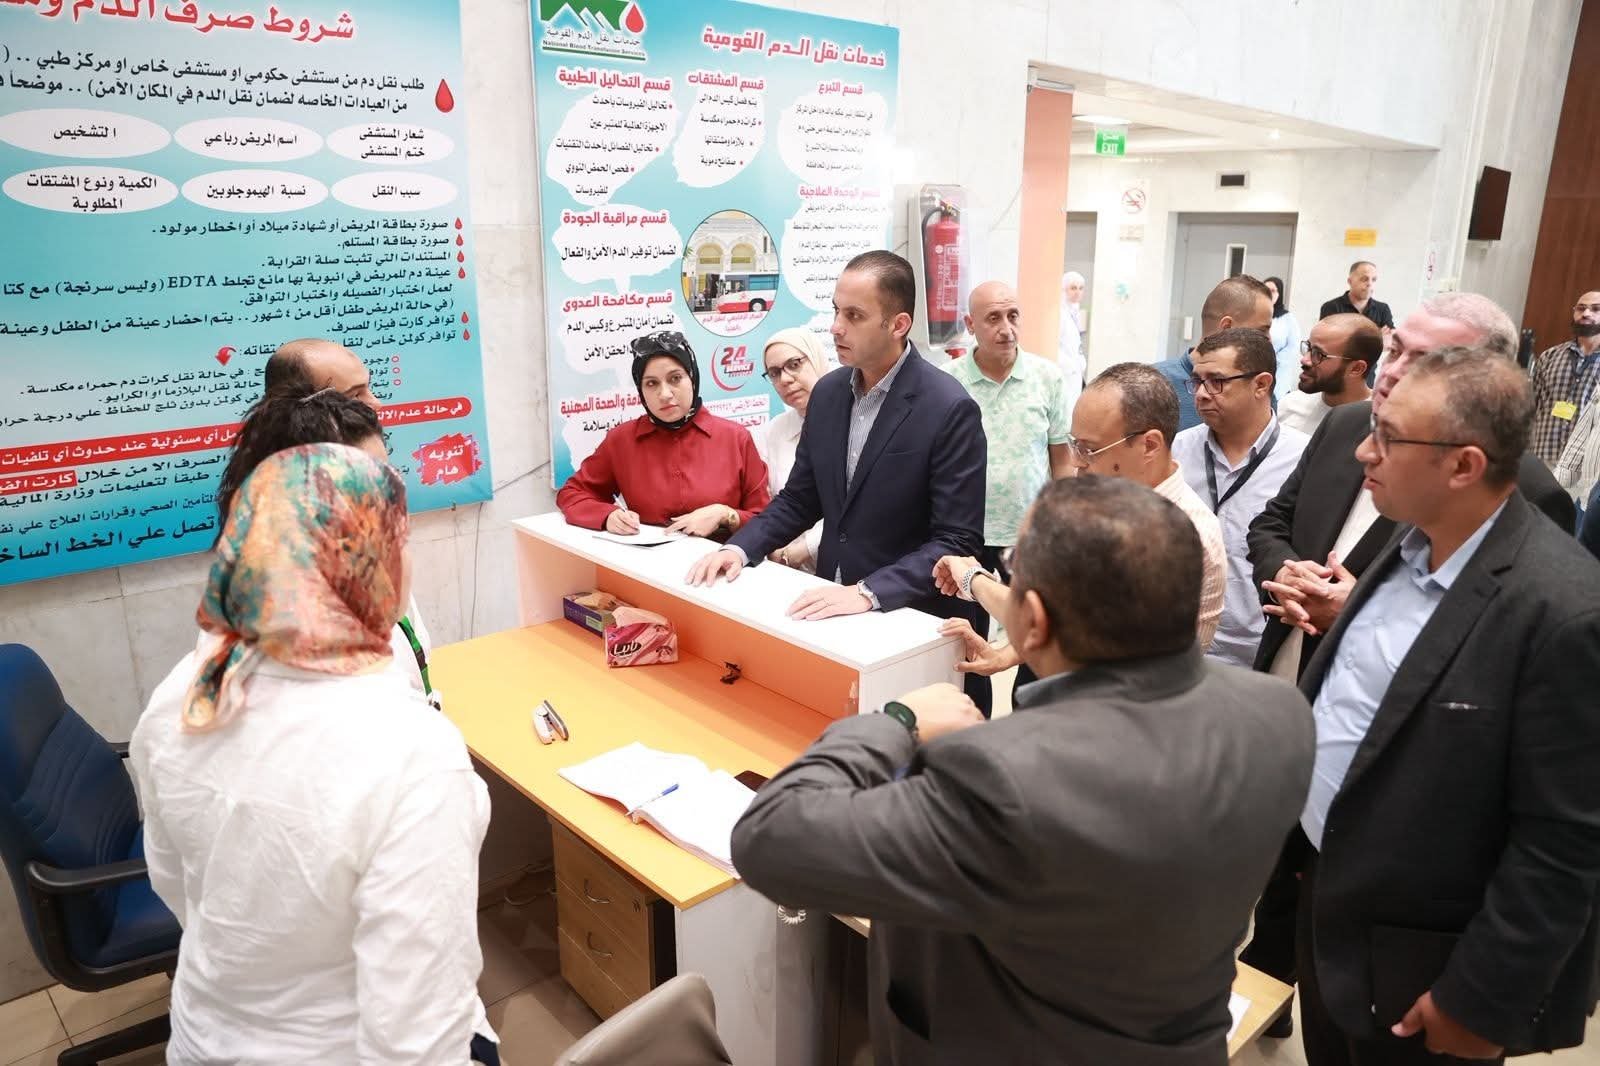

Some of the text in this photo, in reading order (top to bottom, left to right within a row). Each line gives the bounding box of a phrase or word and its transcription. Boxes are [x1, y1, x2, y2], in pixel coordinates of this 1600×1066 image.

[165, 0, 354, 43] شروط صرف
[703, 28, 764, 52] القومية
[813, 41, 838, 63] نقل
[843, 47, 885, 67] خدمات
[36, 50, 425, 90] طلب نقل من مستشفى حكومي مستشفى خاص مركز طبي
[558, 69, 671, 93] قسم التحاليل الطبية
[688, 71, 764, 92] قسم المشتقات
[136, 83, 390, 112] العيادات لضمان نقل الدم في المكان
[842, 84, 863, 96] قسم
[204, 132, 298, 148] اسم المريض رباعي
[359, 127, 425, 141] شعار المستشفى
[360, 146, 425, 160] ختم المستشفى
[1101, 143, 1119, 155] EXIT
[26, 173, 157, 192] الكمية ونوع المشتقات
[206, 184, 306, 199] نسبة الهيموجلوبين
[372, 185, 421, 198] سبب النقل
[72, 196, 123, 212] المطلوبة
[159, 219, 449, 236] صورة بطاقة المريض شهادة ميلاد مولود
[563, 211, 667, 227] قسم مراقبة الجودة
[383, 235, 450, 247] صورة بطاقة
[315, 252, 451, 267] المستندات التي صلة
[561, 245, 591, 261] والفعال
[612, 246, 629, 260] الدم
[629, 245, 652, 259] توفير
[652, 244, 676, 259] لضمان
[29, 269, 451, 299] عينة للمريض مانع تجلط EDTA مع
[294, 283, 453, 303] لعمل اختبار واختبار
[602, 294, 644, 307] مكافحة
[645, 292, 673, 308] قسم
[52, 301, 432, 335] حالة المريض طفل شهور يتم احضار عينة من الطفل
[373, 316, 455, 331] توافر كارت فيزا
[651, 314, 674, 329] لضمان
[566, 320, 585, 335] الدم
[366, 331, 456, 349] توافر خاص
[720, 345, 746, 366] 24
[77, 374, 169, 393] كرات حمراء
[34, 403, 150, 423] للحفاظ درجة
[424, 405, 448, 415] حالة
[560, 393, 625, 417] والصحة المهنية
[1, 442, 147, 466] عند حدوث تلفيات
[428, 444, 465, 461] تنويه
[32, 454, 227, 488] الصرف خلال كارت
[435, 465, 459, 480] هام
[54, 476, 167, 501] لتعليمات وزارة
[140, 501, 178, 517] الصحي
[50, 513, 86, 530] العلاج
[65, 531, 123, 552] الخط
